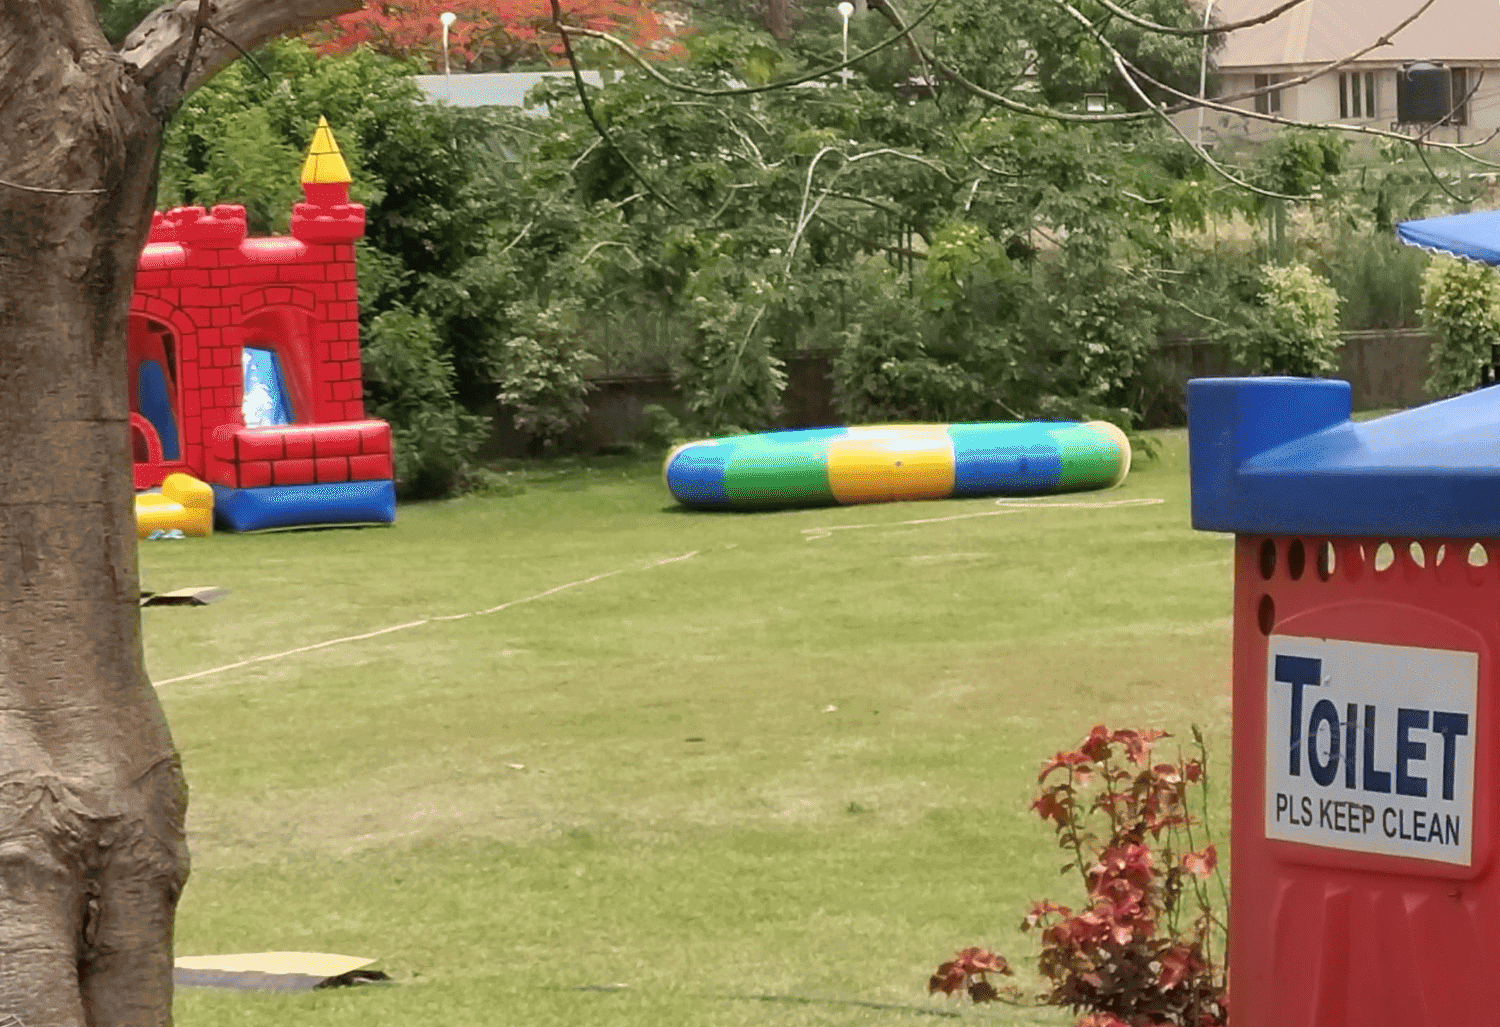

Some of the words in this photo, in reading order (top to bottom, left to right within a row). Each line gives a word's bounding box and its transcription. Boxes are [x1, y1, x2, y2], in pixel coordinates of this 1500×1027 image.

[1274, 654, 1469, 801] TOILET
[1276, 793, 1313, 827] PLS
[1319, 798, 1375, 834] KEEP
[1382, 807, 1460, 846] CLEAN
